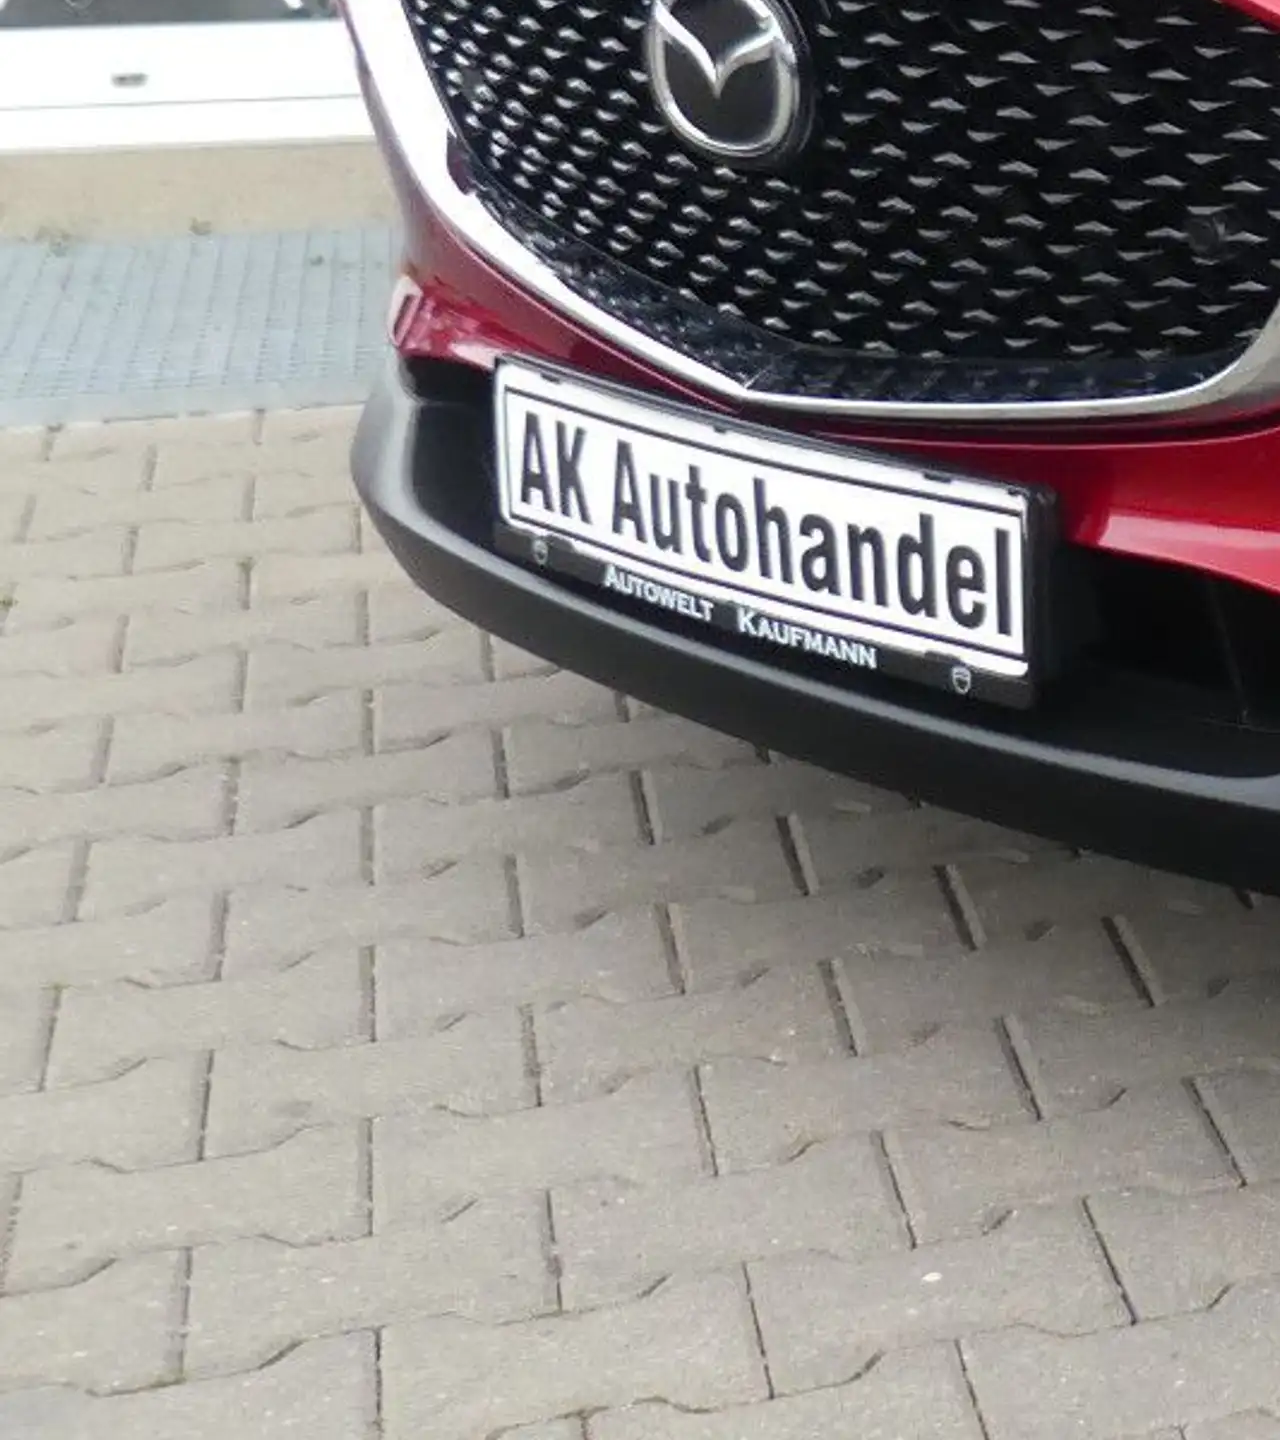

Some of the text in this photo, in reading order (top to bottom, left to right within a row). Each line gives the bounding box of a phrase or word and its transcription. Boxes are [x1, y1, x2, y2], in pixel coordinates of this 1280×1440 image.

[520, 411, 1013, 637] AK Autohandel
[604, 563, 877, 669] AUTOWELT KAUFMANN
